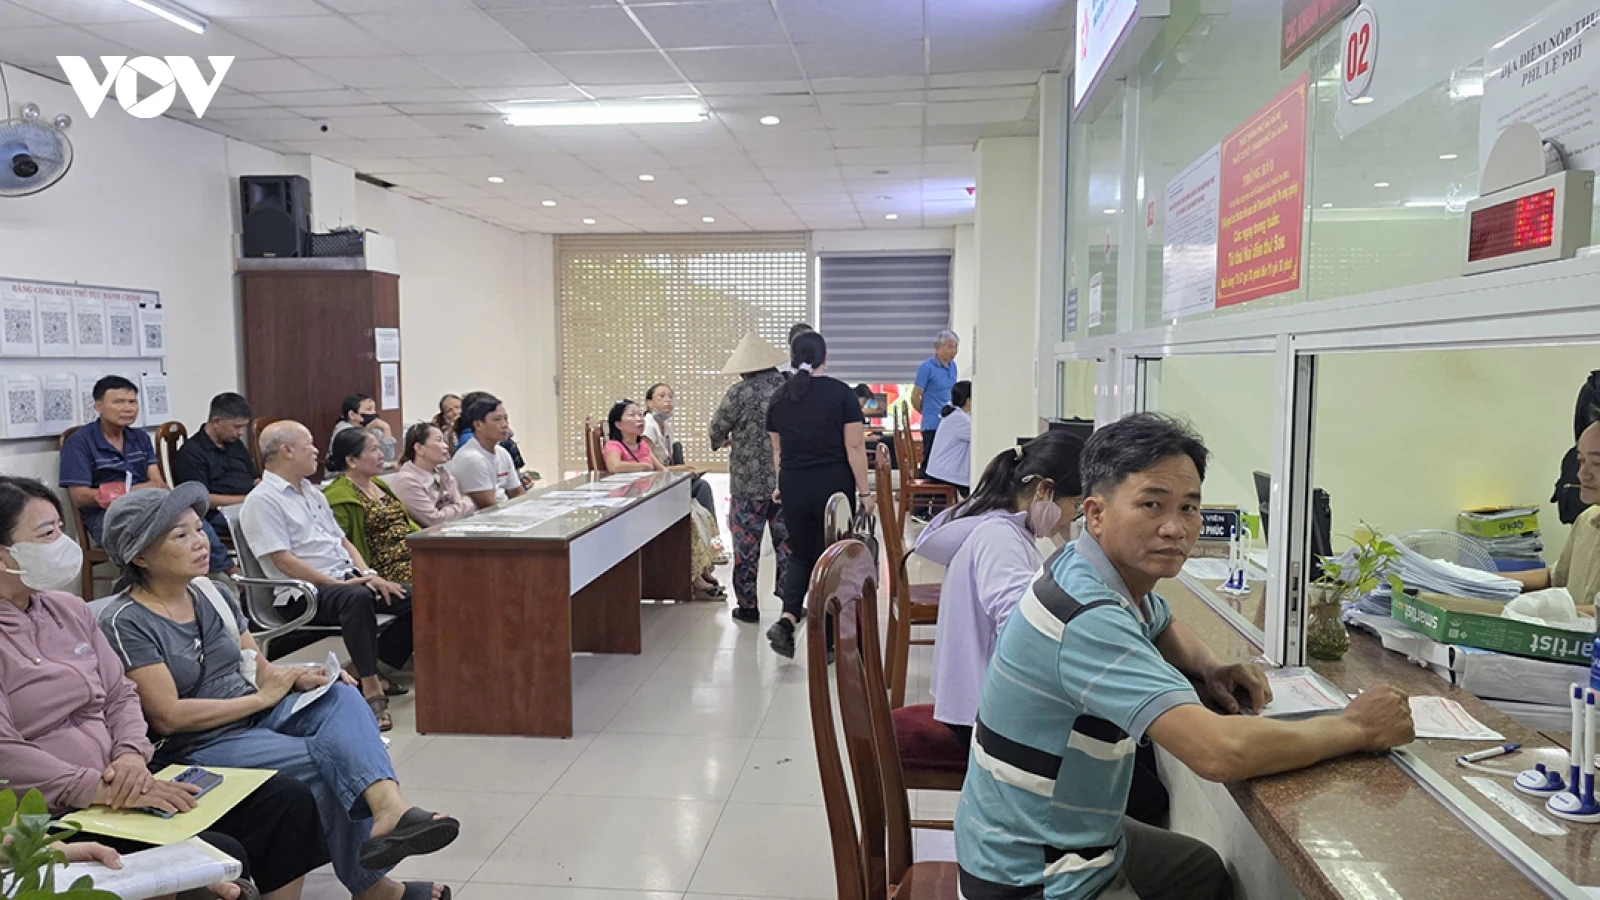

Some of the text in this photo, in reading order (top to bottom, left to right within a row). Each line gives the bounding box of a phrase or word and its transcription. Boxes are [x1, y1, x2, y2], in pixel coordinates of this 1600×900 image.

[1347, 23, 1370, 82] 02
[1561, 39, 1583, 68] PHÍ
[1205, 514, 1225, 522] VIÊN
[1205, 524, 1225, 535] PHÚC
